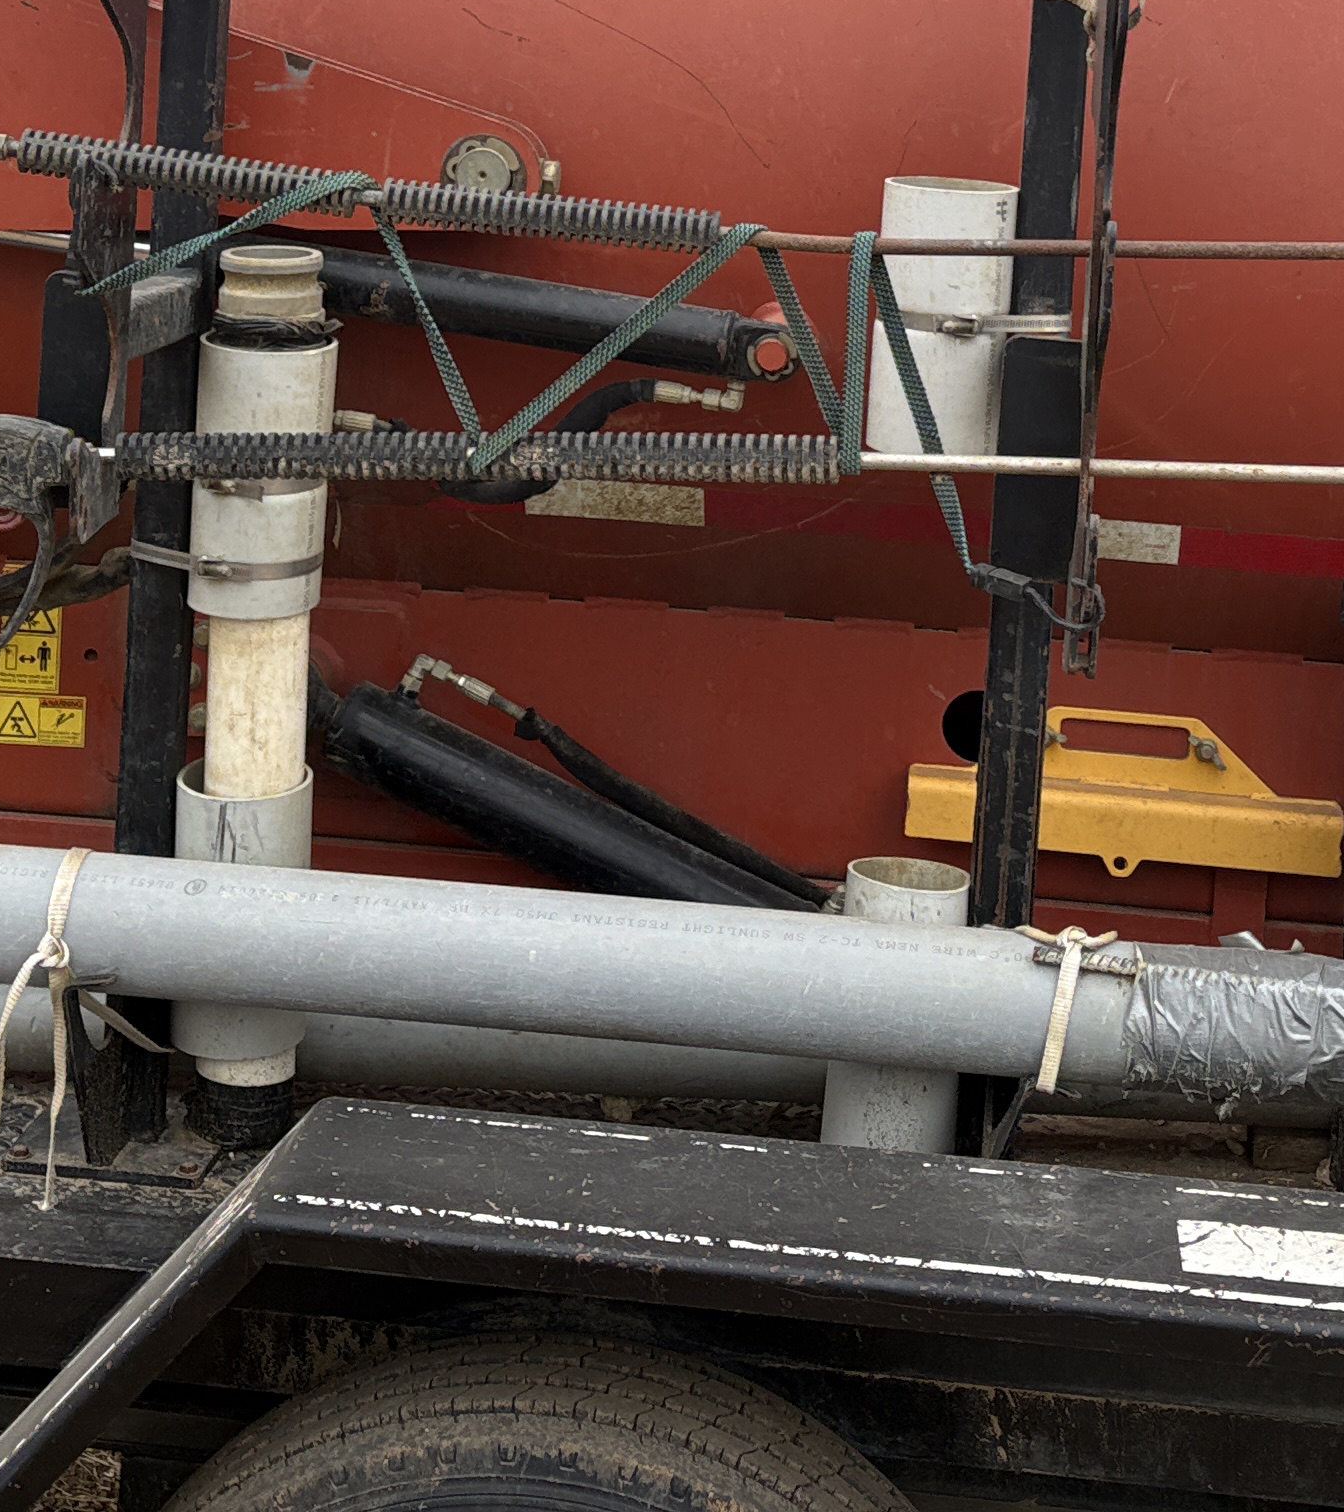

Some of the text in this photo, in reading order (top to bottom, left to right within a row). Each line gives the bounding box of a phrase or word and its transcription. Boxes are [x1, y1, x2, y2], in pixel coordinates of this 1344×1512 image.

[570, 912, 670, 931] RESISTANT
[681, 922, 771, 939] SUNLIGHT
[818, 934, 862, 948] TC-2
[875, 939, 920, 953] NEMA
[931, 944, 977, 958] WIRE
